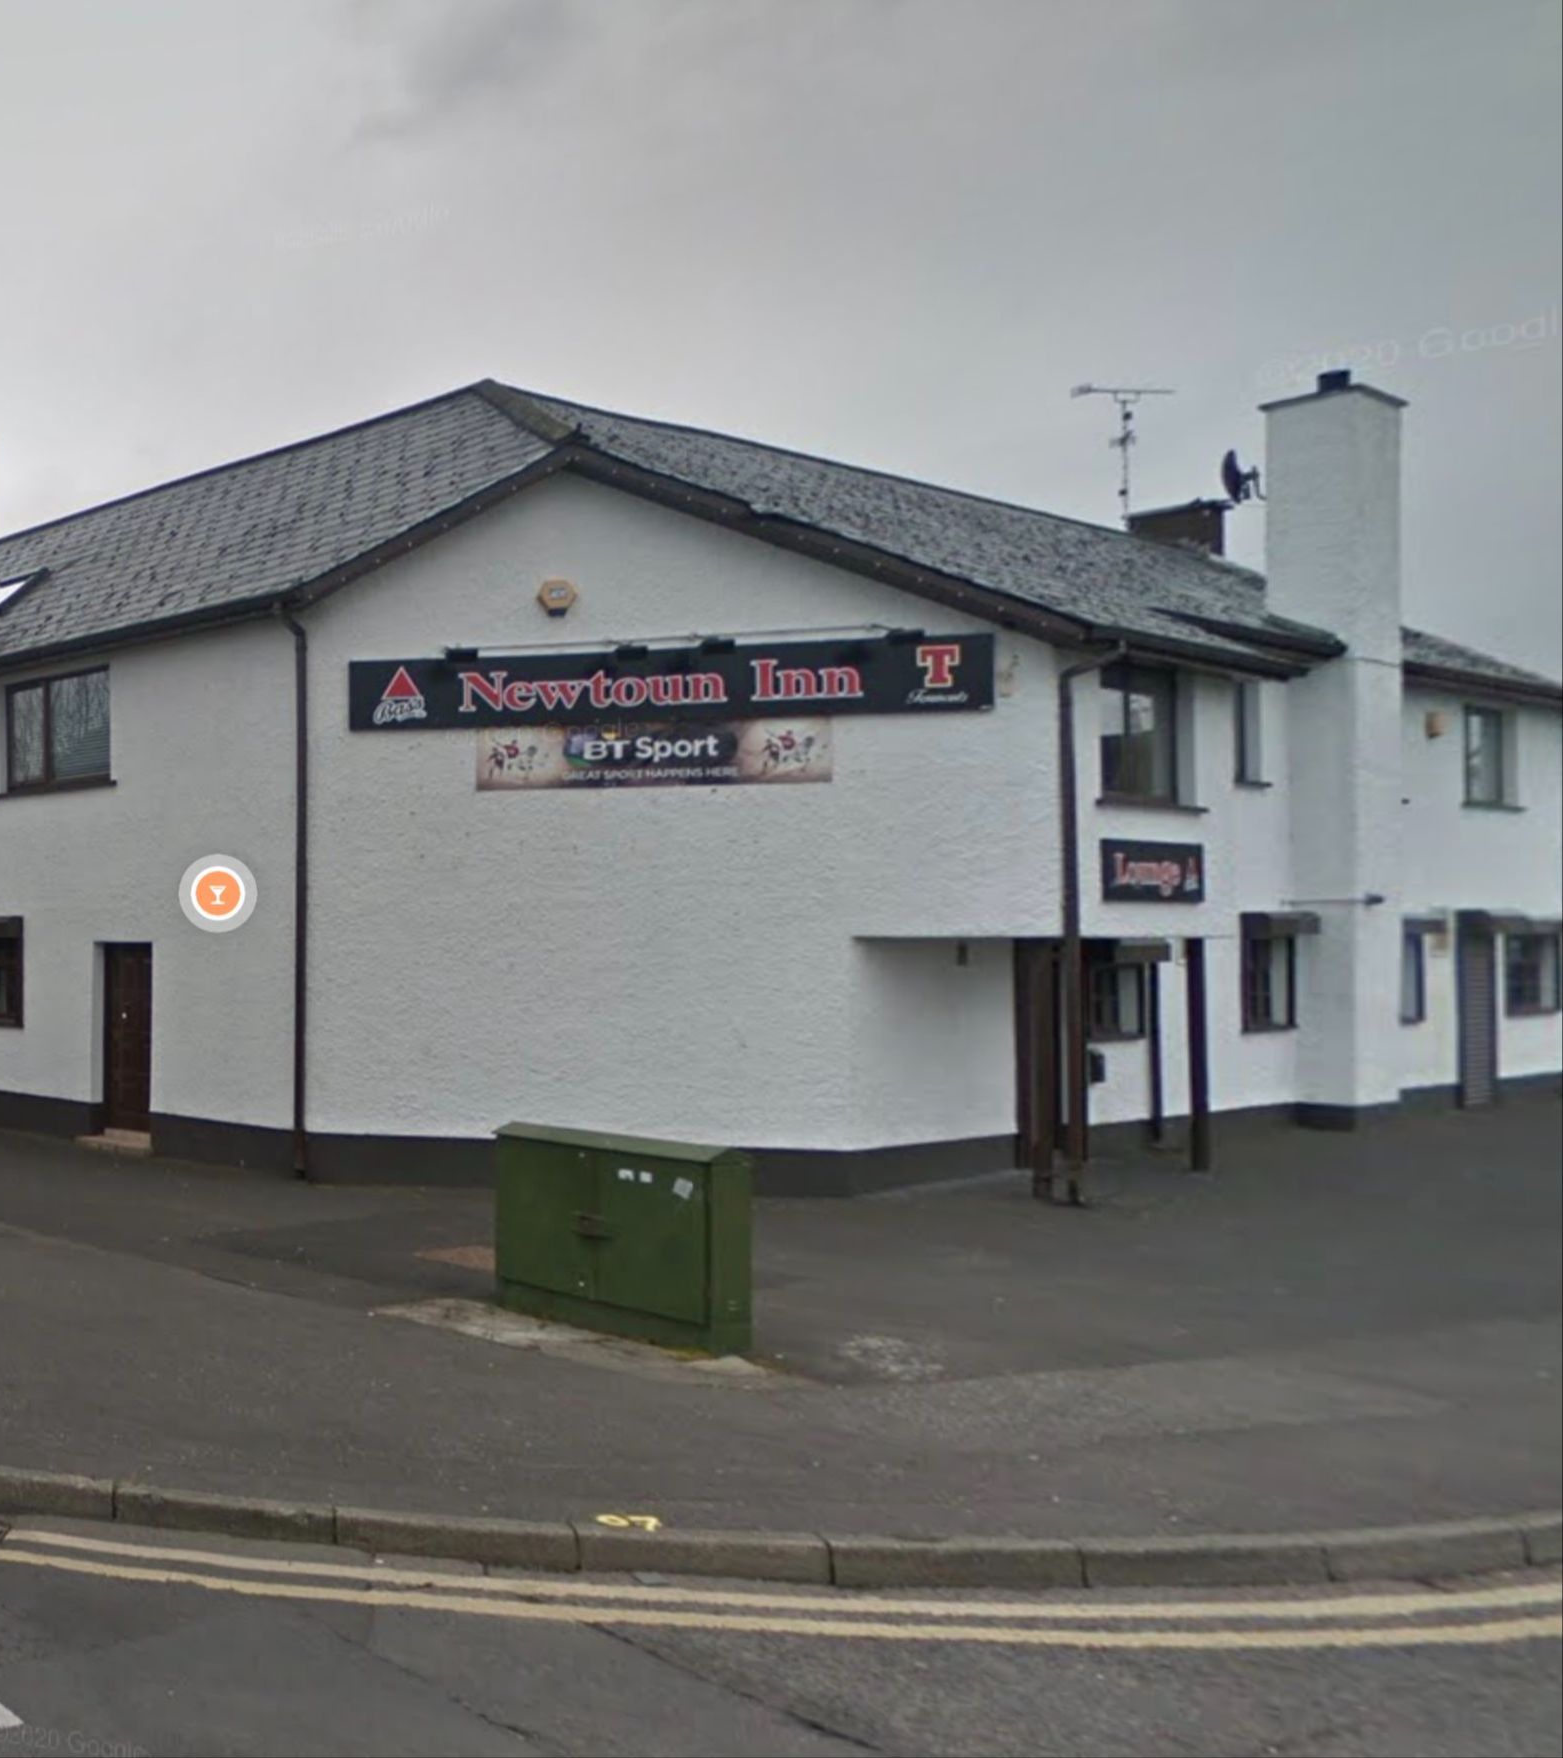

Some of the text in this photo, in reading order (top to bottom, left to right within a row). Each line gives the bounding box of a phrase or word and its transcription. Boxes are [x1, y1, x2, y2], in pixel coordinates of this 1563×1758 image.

[458, 658, 864, 712] Newtoun Inn
[916, 644, 960, 688] T
[582, 735, 719, 763] BT Sport
[562, 766, 739, 781] GREAT SPORT HAPPENS HERE
[1113, 852, 1181, 897] Lounge
